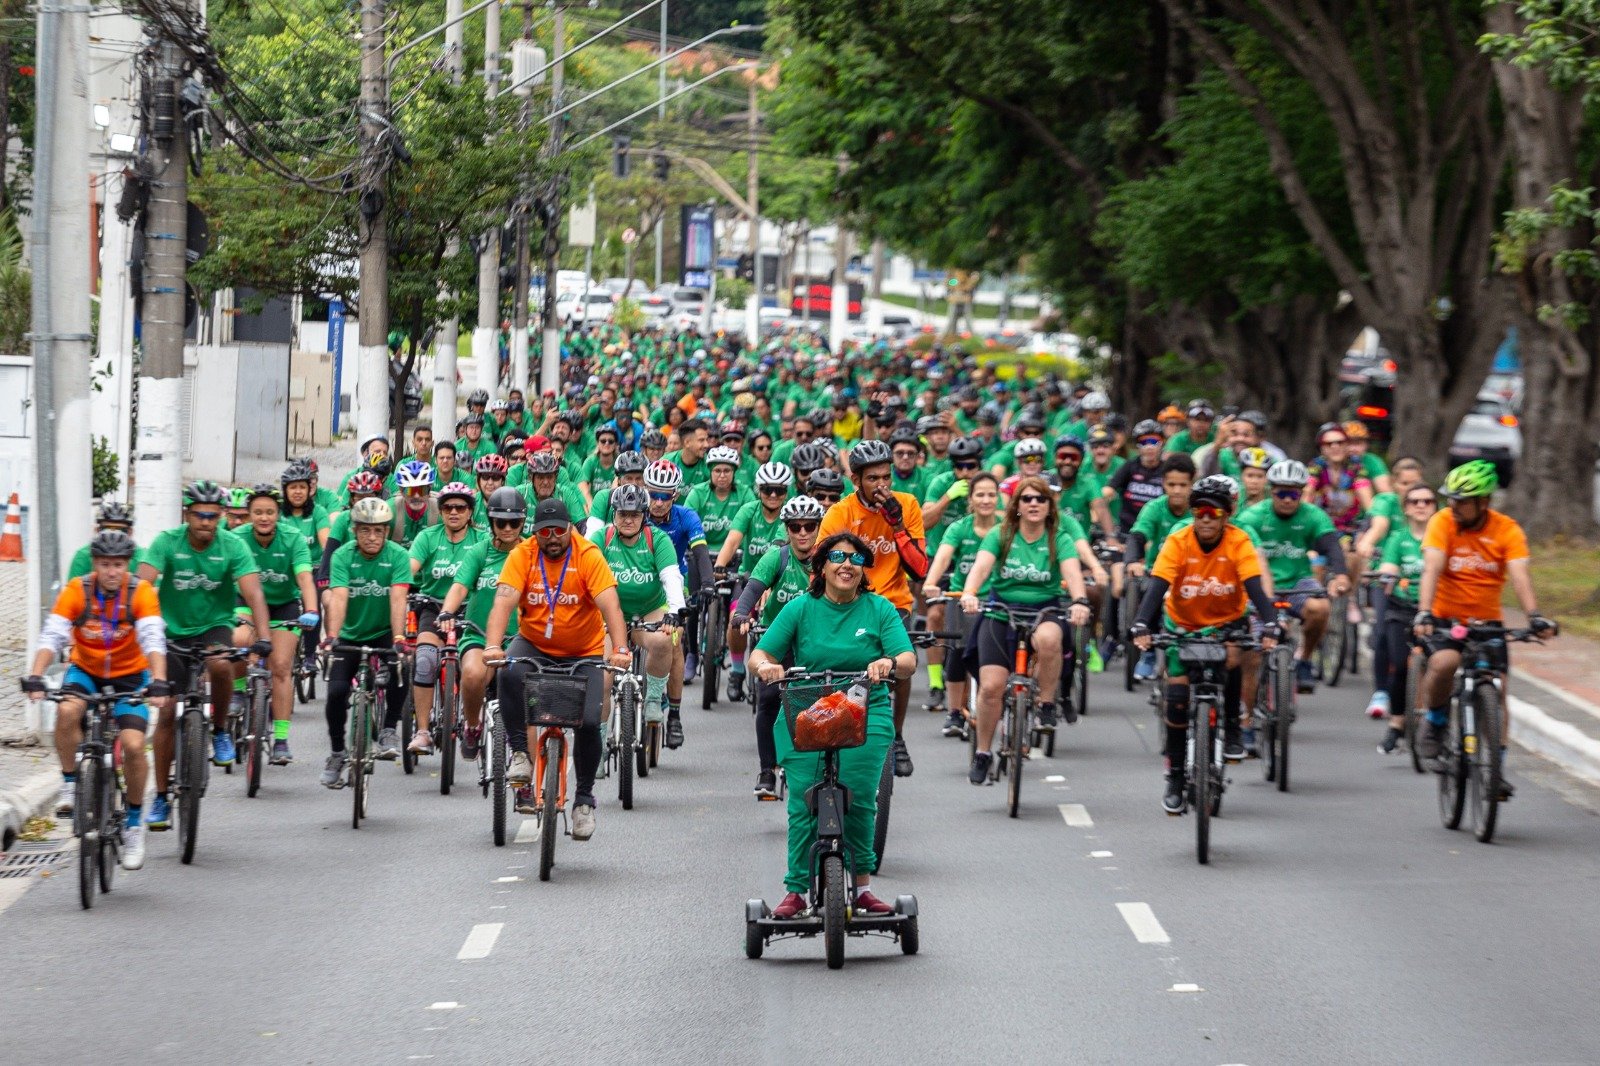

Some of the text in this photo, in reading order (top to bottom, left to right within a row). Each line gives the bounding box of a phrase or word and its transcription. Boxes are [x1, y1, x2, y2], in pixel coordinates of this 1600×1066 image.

[431, 561, 463, 580] gre
[612, 567, 654, 584] reen
[1000, 563, 1051, 582] green
[476, 574, 499, 591] gre
[1180, 576, 1235, 599] green
